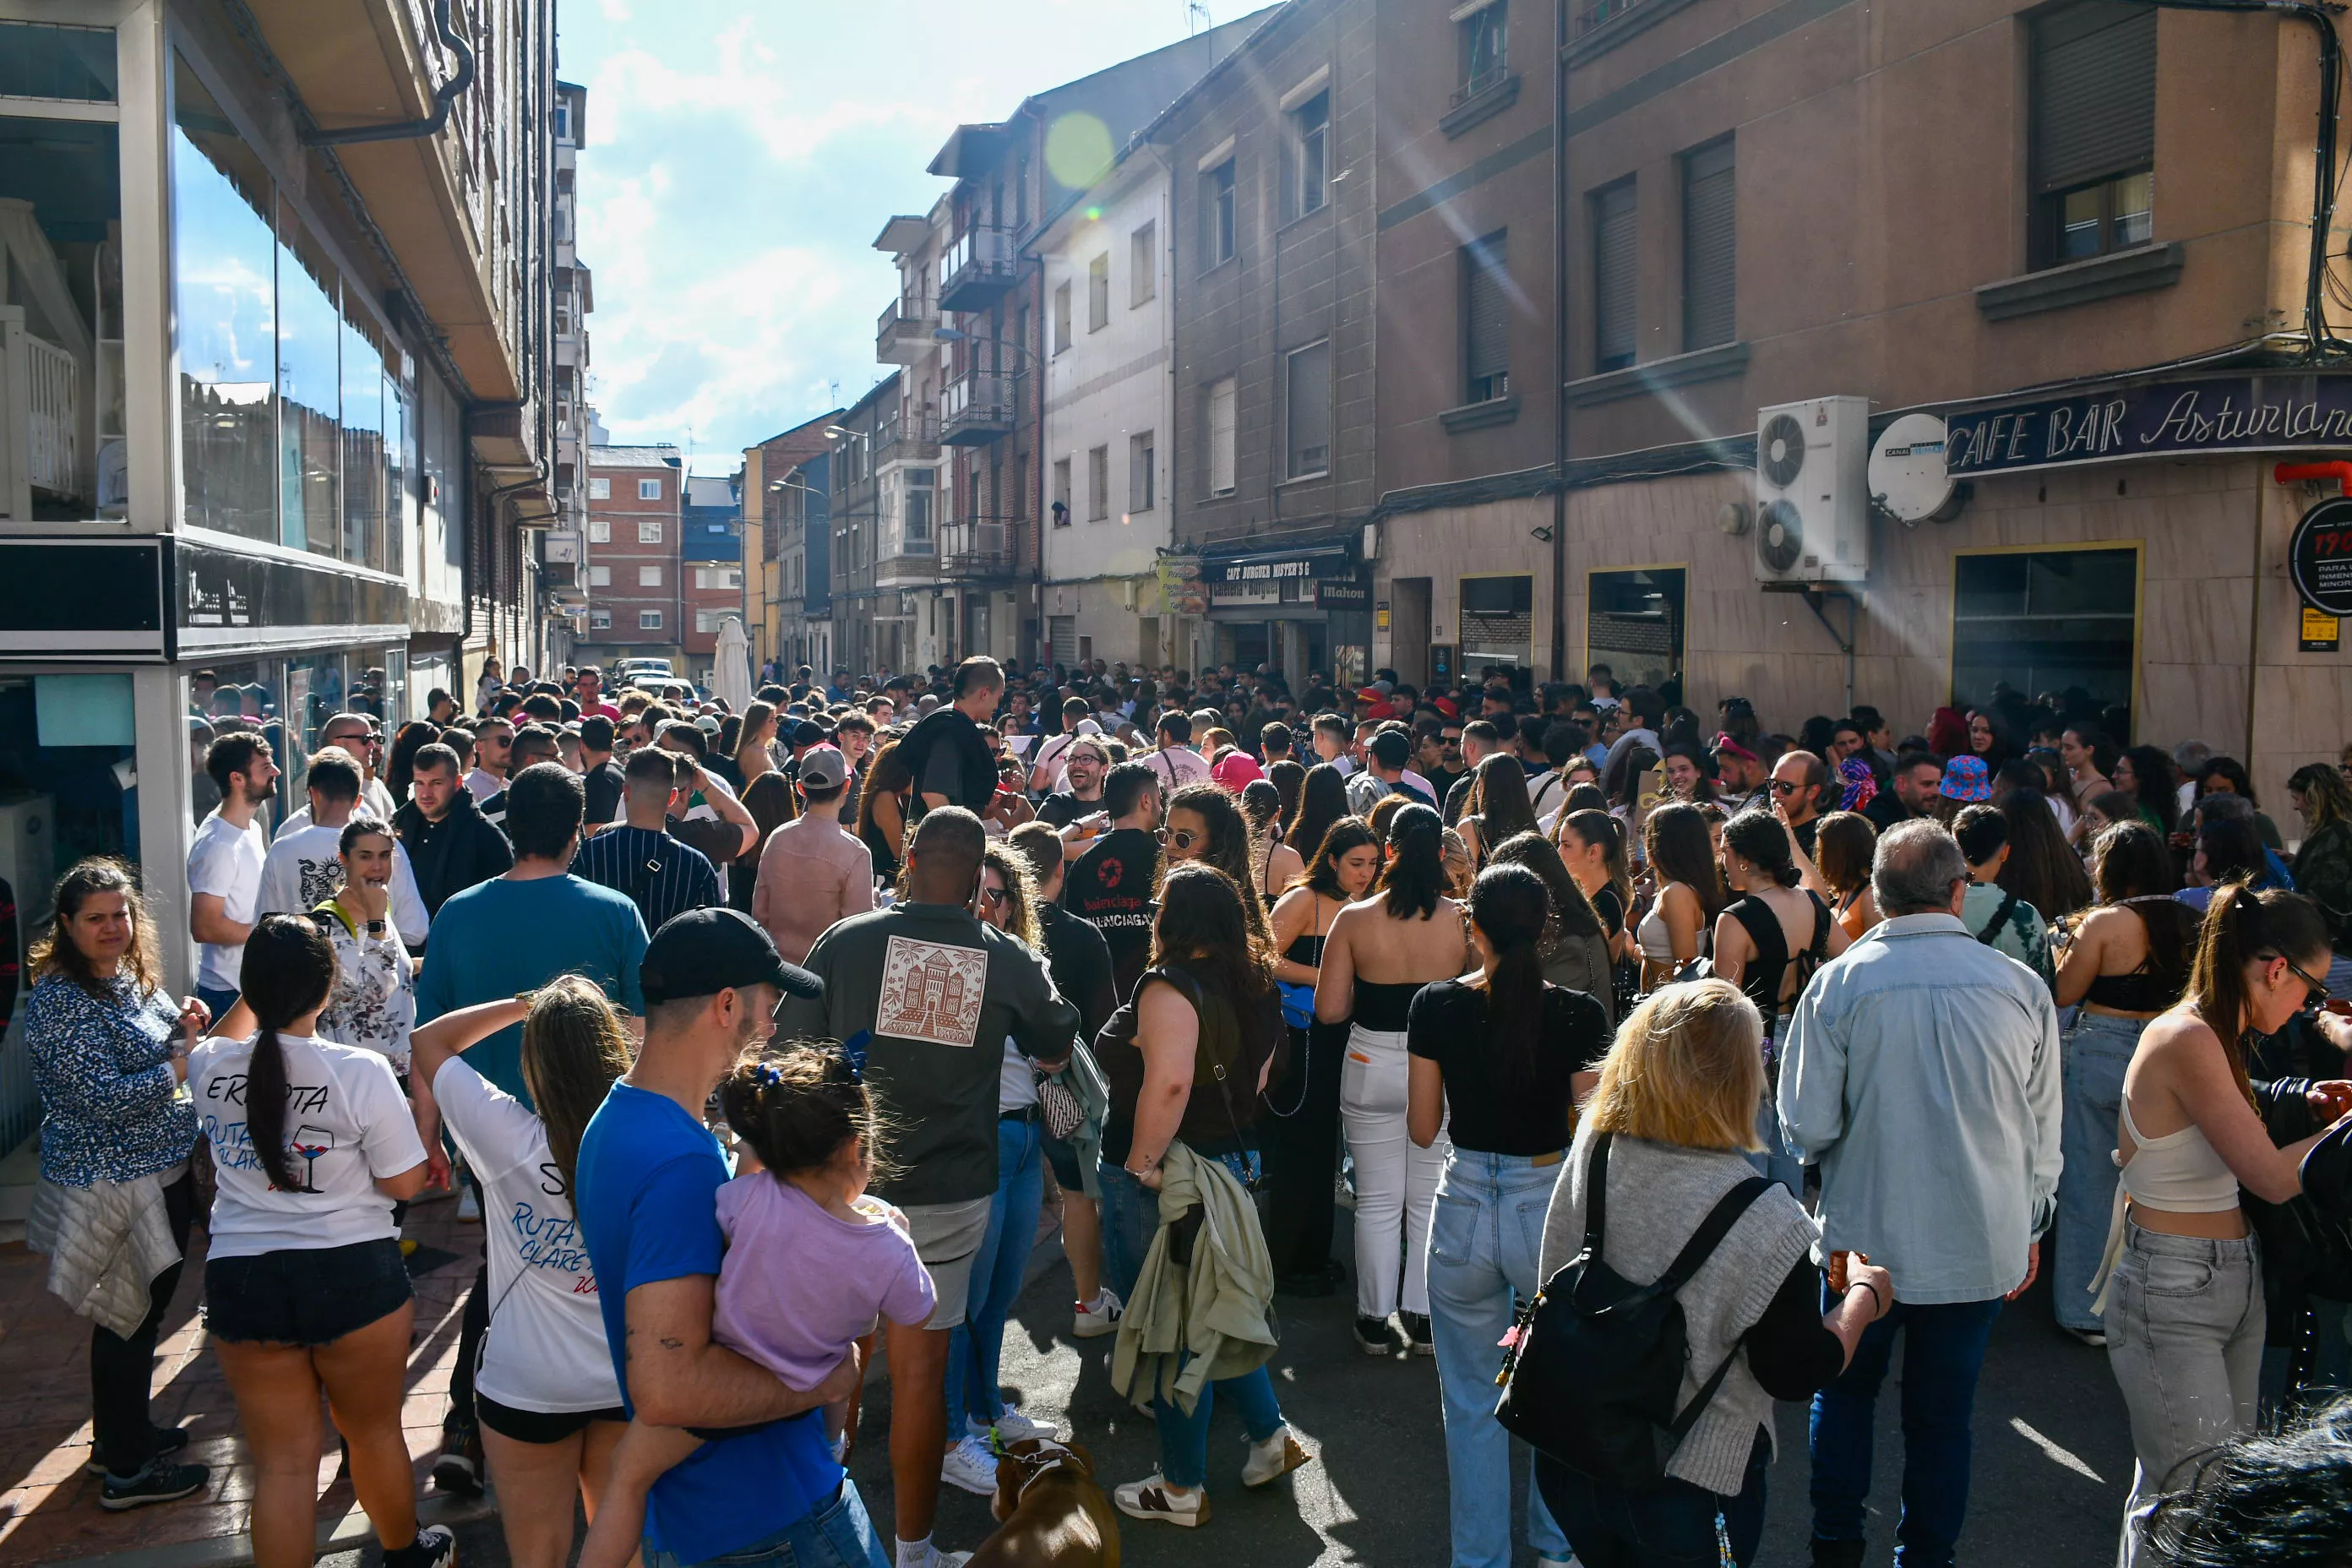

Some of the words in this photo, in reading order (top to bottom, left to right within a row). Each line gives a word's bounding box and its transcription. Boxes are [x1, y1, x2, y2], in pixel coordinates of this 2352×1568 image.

[1944, 411, 2036, 466] CAFE
[2046, 399, 2126, 458] BAR
[1227, 565, 1240, 580] CAFÉ
[1242, 564, 1271, 580] BURGUER
[1273, 562, 1304, 578] MISTER'S
[1323, 585, 1364, 599] Mahou
[512, 1201, 575, 1246] RUTA
[520, 1239, 593, 1273] CLARE
